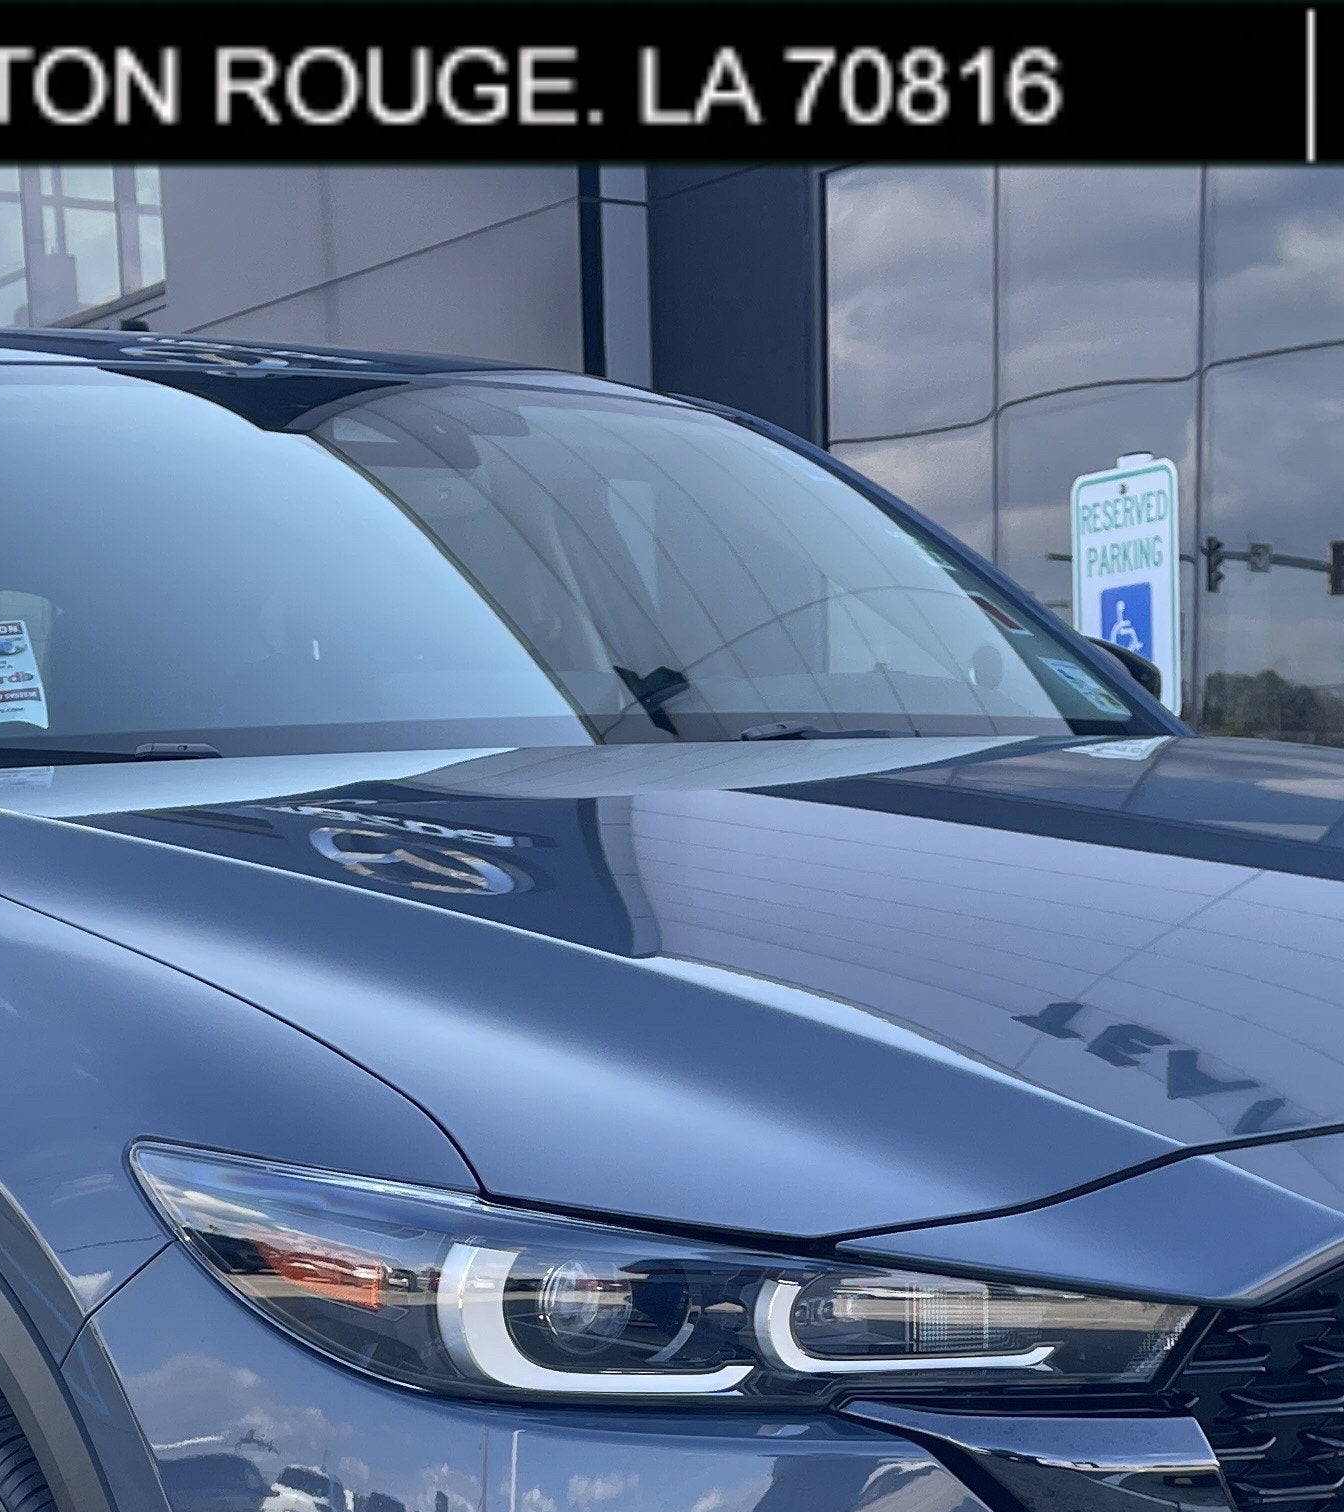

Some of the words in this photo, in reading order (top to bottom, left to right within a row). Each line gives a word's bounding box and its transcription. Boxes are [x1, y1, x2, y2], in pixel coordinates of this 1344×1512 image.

[1080, 489, 1168, 535] RESERVED
[1086, 535, 1163, 578] PARKING
[4, 691, 37, 701] SYSTEM
